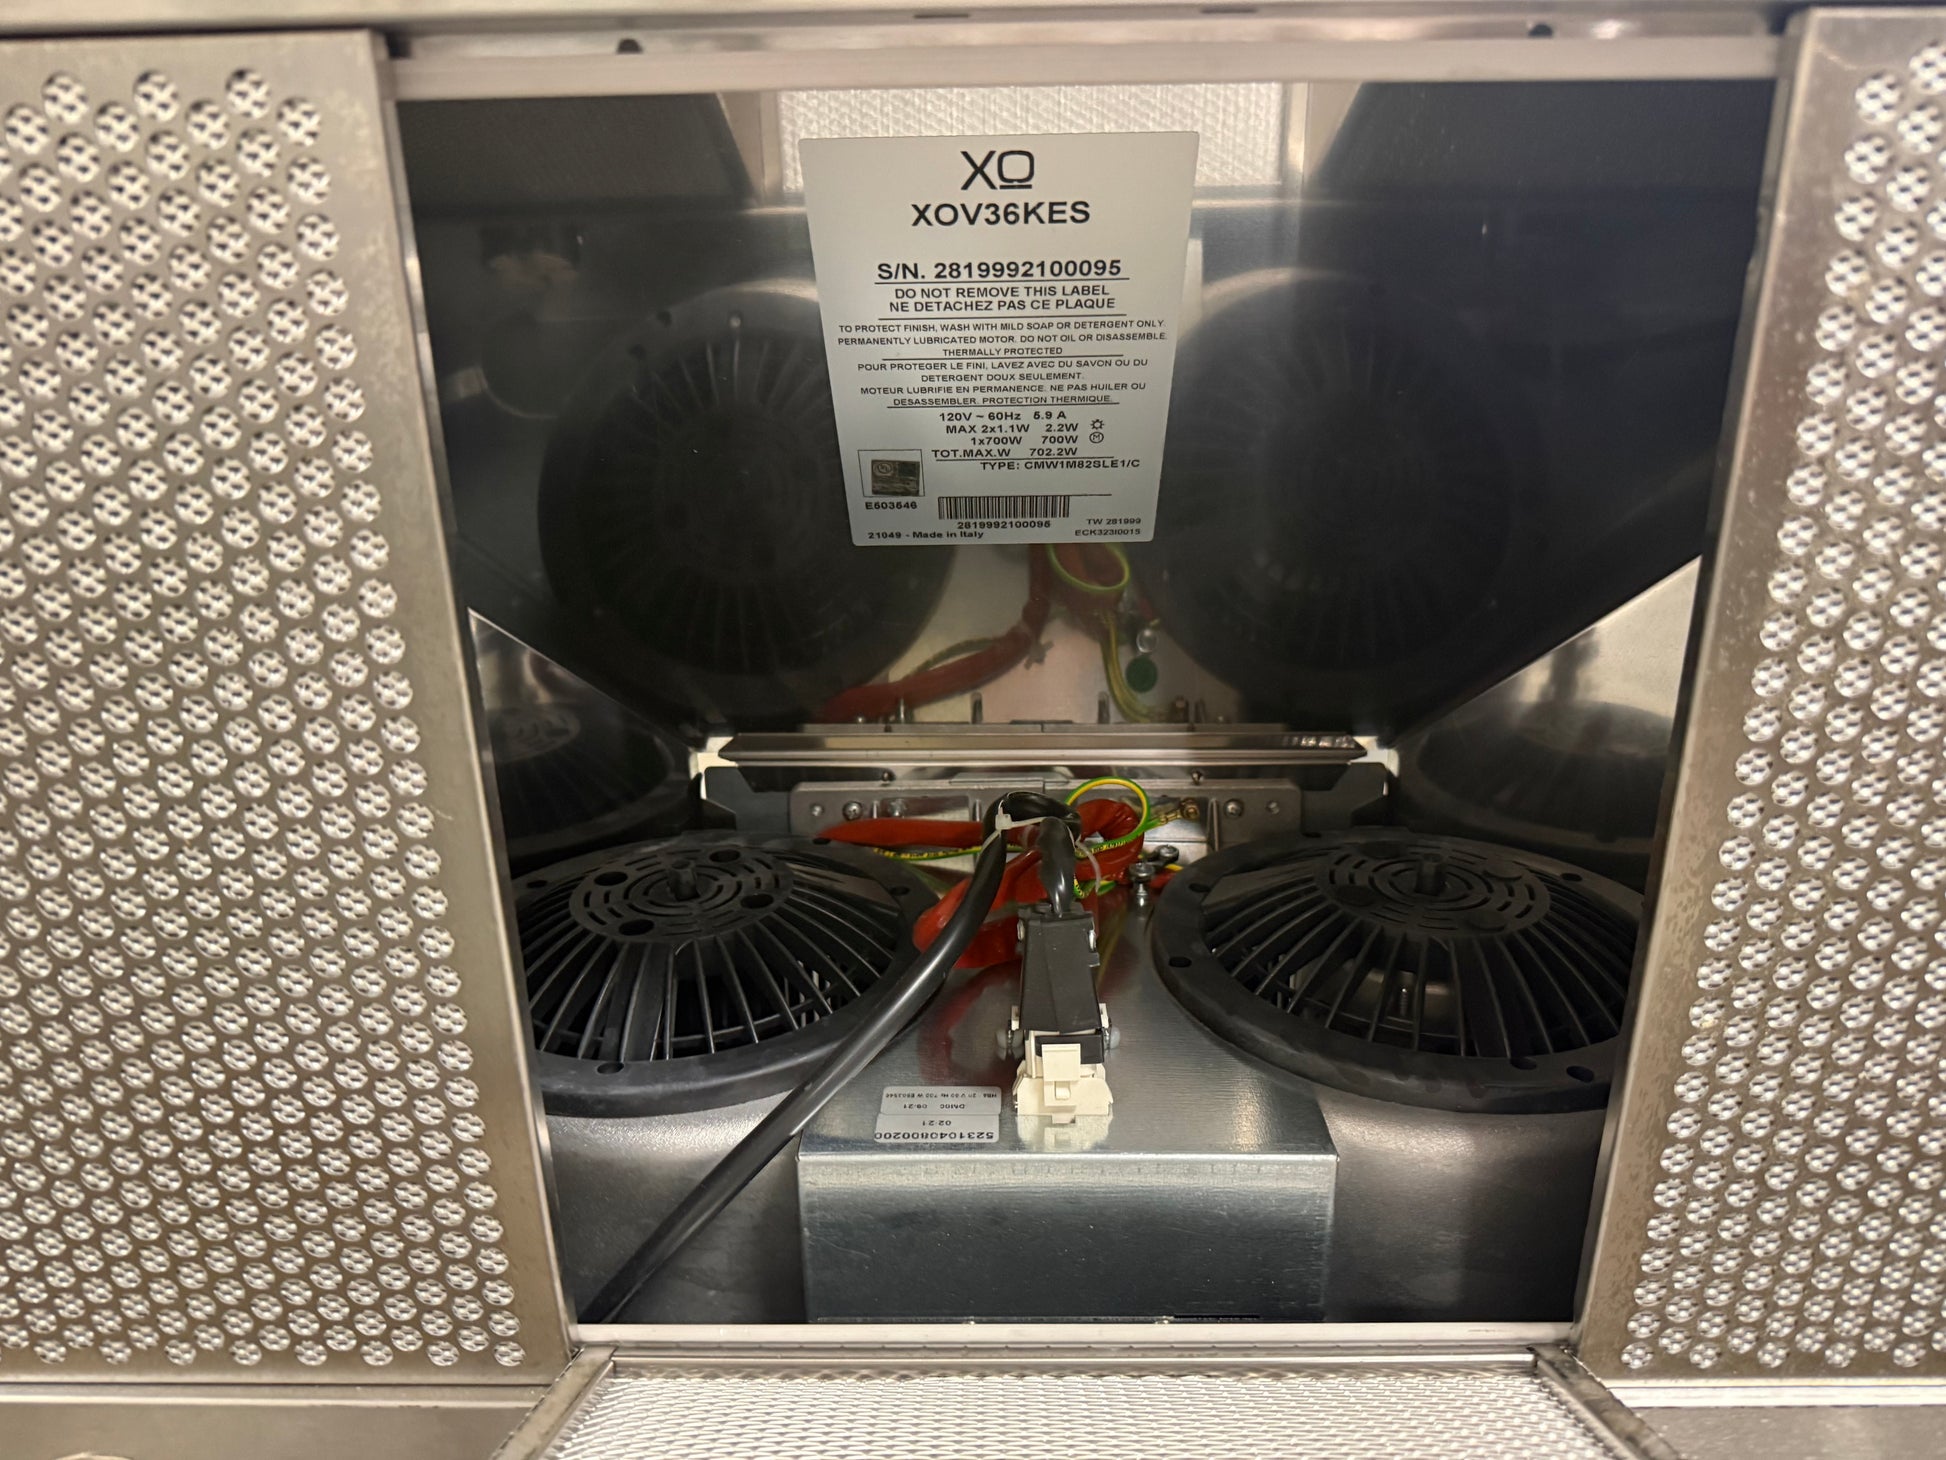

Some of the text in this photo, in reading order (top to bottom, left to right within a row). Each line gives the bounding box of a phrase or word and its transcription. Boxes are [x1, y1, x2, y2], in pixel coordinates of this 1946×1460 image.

[960, 150, 1034, 190] XO
[911, 201, 1091, 227] XOV36KES
[877, 259, 1122, 280] S/N. 2819992100095
[895, 285, 1110, 299] DO NOT REMOVE THIS LABEL
[889, 298, 1115, 312] NE DETACHEZ PAS CE PLAQUE
[839, 325, 852, 333] TO
[904, 324, 938, 333] FINISH,
[972, 323, 997, 331] WITH
[1027, 322, 1053, 330] SOAP
[1074, 321, 1134, 329] DETERGENT
[1137, 320, 1166, 328] ONLY.
[838, 337, 911, 345] PERMANENTLY
[979, 335, 1016, 344] MOTOR.
[1096, 333, 1167, 341] DISASSEMBLE.
[1004, 347, 1062, 355] PROTECTED
[991, 361, 1024, 369] LAVEZ
[922, 374, 983, 382] DETERGENT
[1019, 372, 1084, 380] SEULEMENT.
[1091, 383, 1128, 391] HUILER
[939, 412, 972, 421] 120V
[988, 412, 1021, 421] 60Hz
[1033, 411, 1053, 420] 5.9
[1057, 411, 1066, 419] A
[946, 423, 1079, 434] MAX 2x1.1W 2.2W
[971, 437, 1023, 445] 1x700W
[1041, 435, 1078, 444] 700W
[932, 448, 1078, 458] TOT.MAX.W 702.2W
[981, 460, 1140, 471] TYPE: CMW1M82SLE1/C
[957, 520, 1051, 530] 2819992100095
